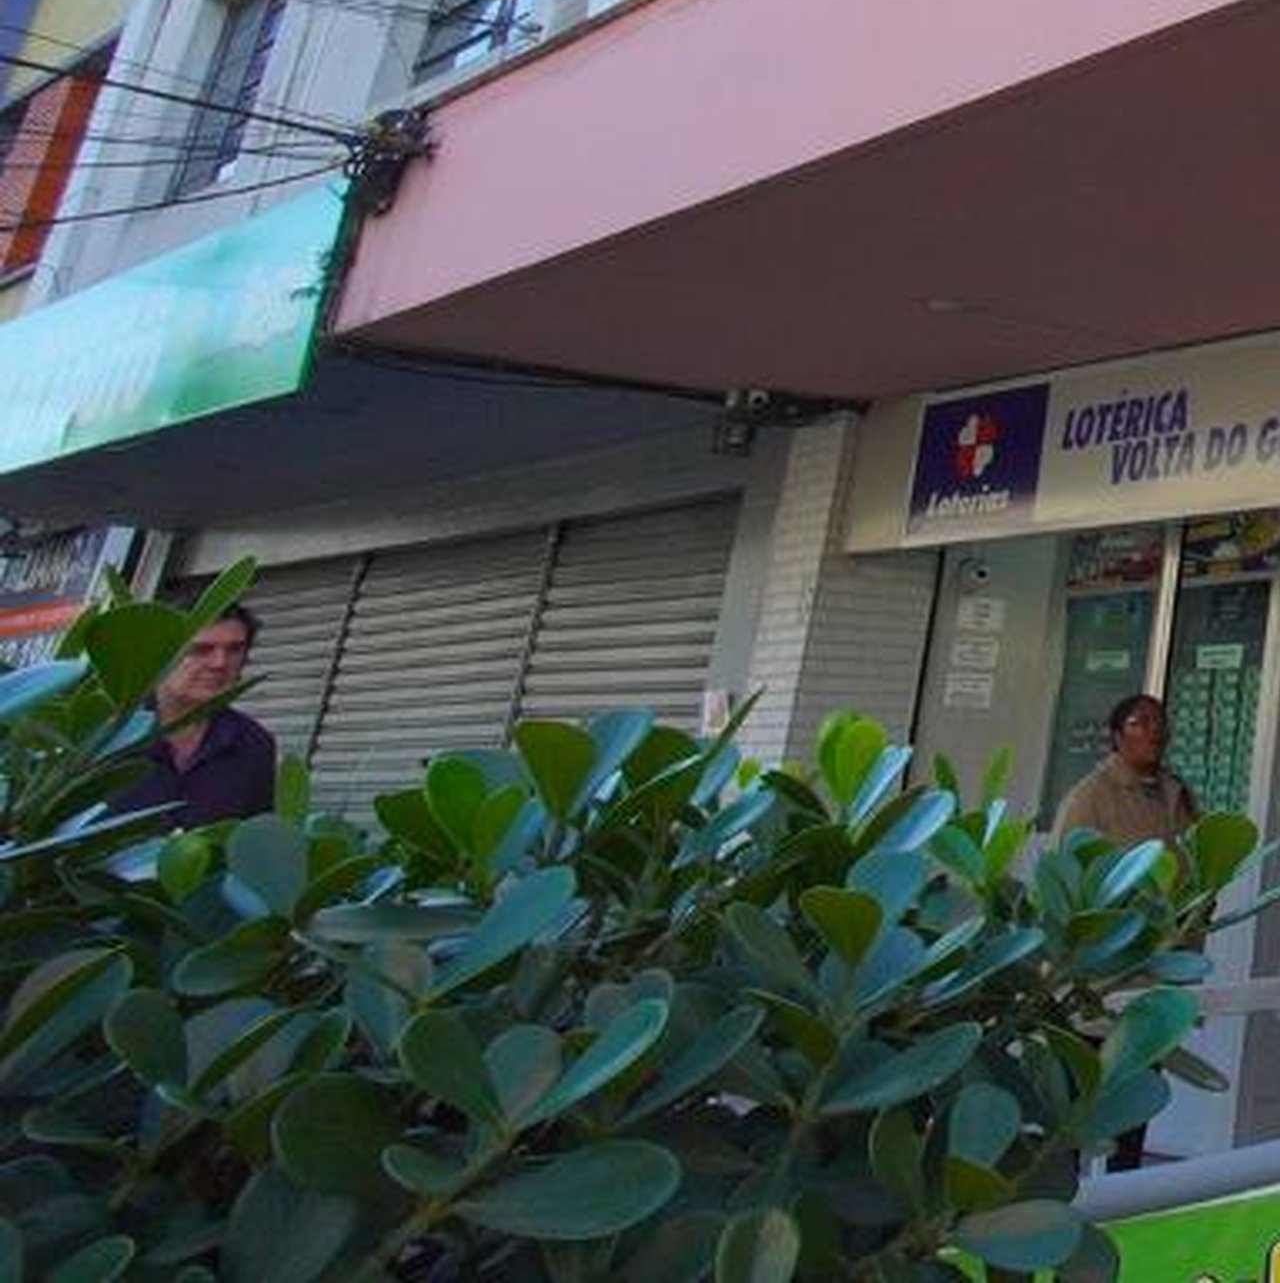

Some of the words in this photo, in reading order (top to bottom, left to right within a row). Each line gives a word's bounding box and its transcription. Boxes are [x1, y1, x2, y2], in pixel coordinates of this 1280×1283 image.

[1061, 388, 1188, 451] LOTÉRICA
[1110, 432, 1196, 485] VOLTA
[1203, 423, 1248, 471] DO
